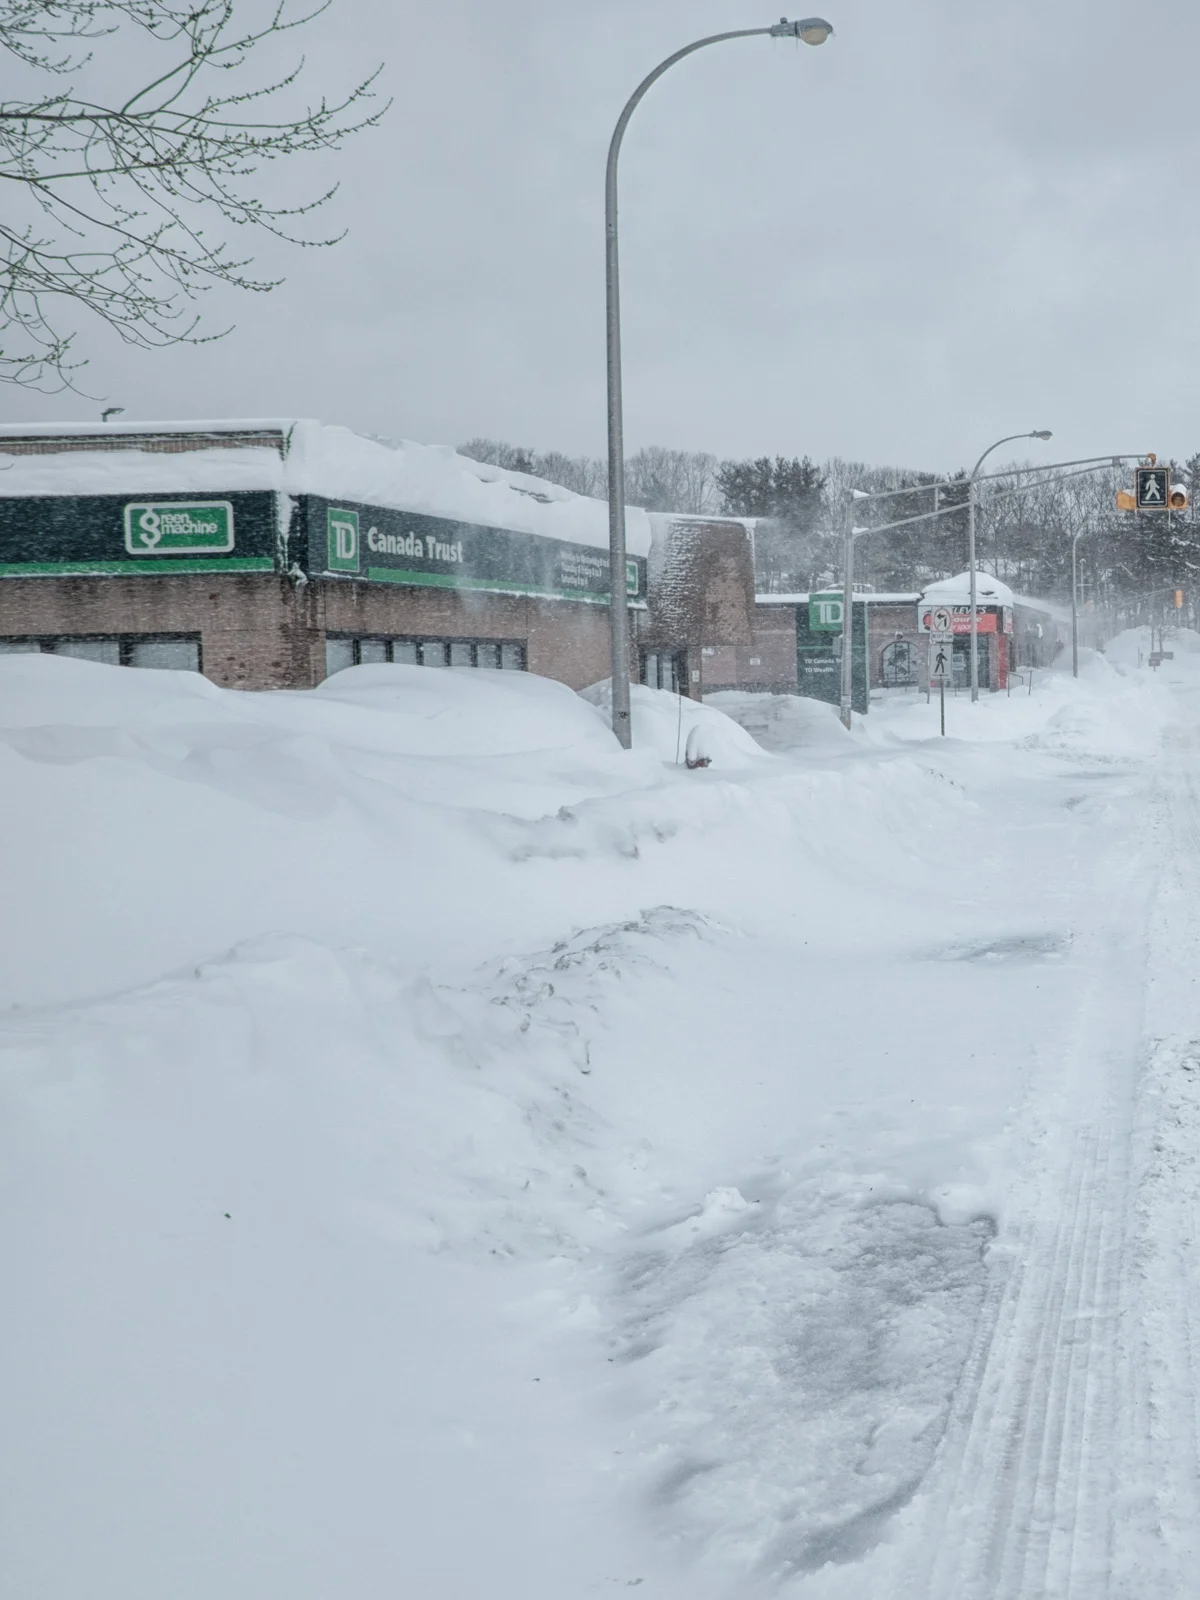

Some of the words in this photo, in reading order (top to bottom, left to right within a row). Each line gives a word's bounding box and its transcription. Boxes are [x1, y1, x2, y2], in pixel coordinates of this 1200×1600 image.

[161, 520, 218, 535] machine
[331, 521, 356, 559] TD
[367, 526, 424, 558] Canada
[426, 535, 464, 563] Trust
[813, 601, 844, 624] TD
